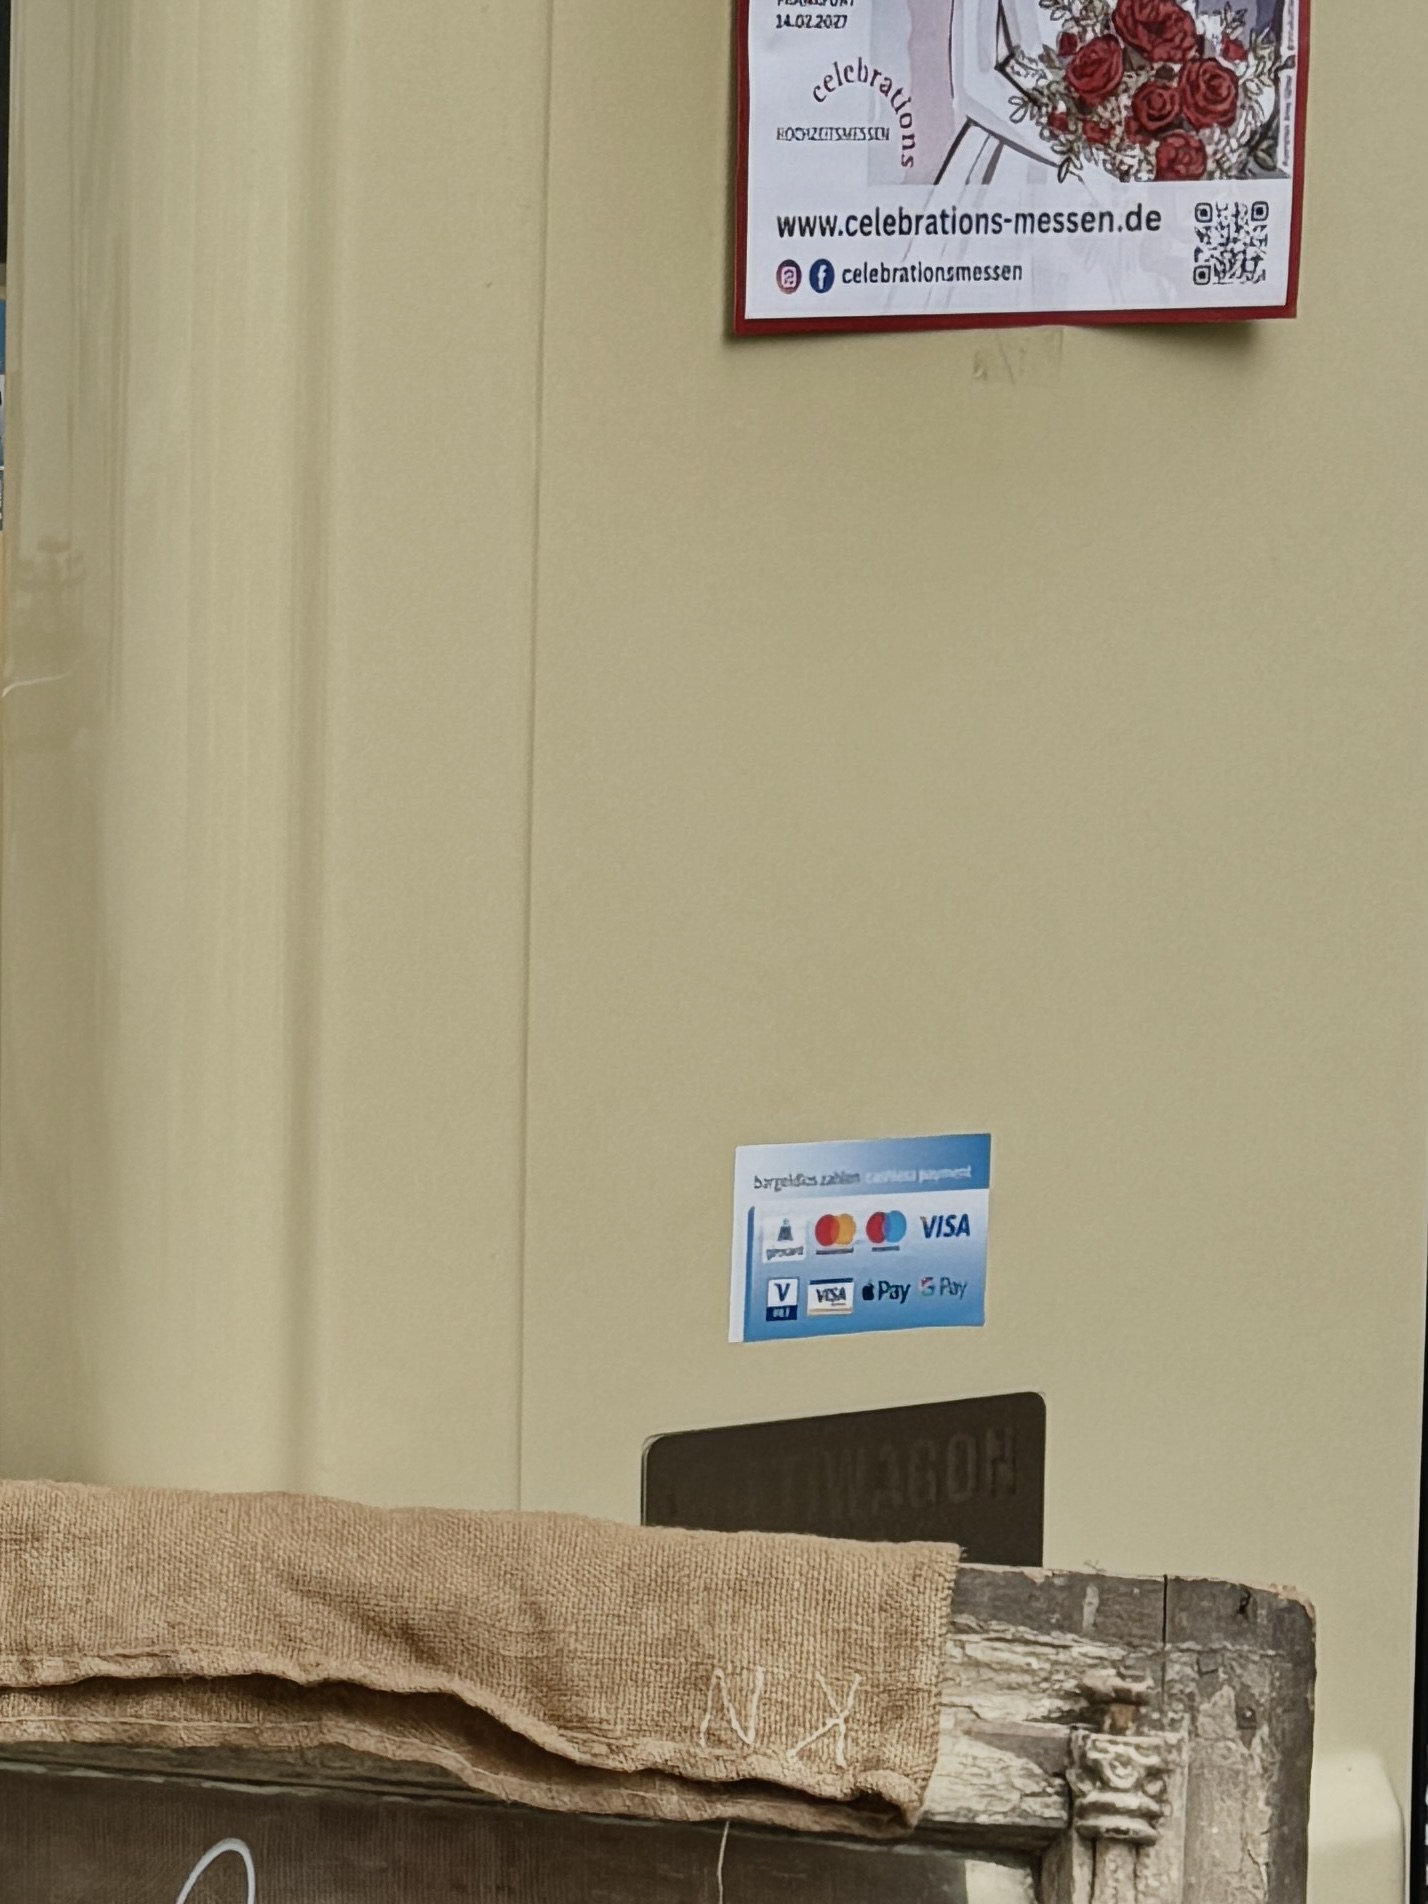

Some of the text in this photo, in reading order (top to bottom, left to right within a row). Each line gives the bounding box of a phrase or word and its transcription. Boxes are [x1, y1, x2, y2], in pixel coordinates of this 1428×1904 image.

[812, 56, 917, 170] celebrations
[776, 202, 1162, 238] www.celebrations-messen.de
[841, 260, 1024, 285] celebrationsmessen
[920, 1213, 971, 1239] VISA
[878, 1280, 912, 1304] Pay
